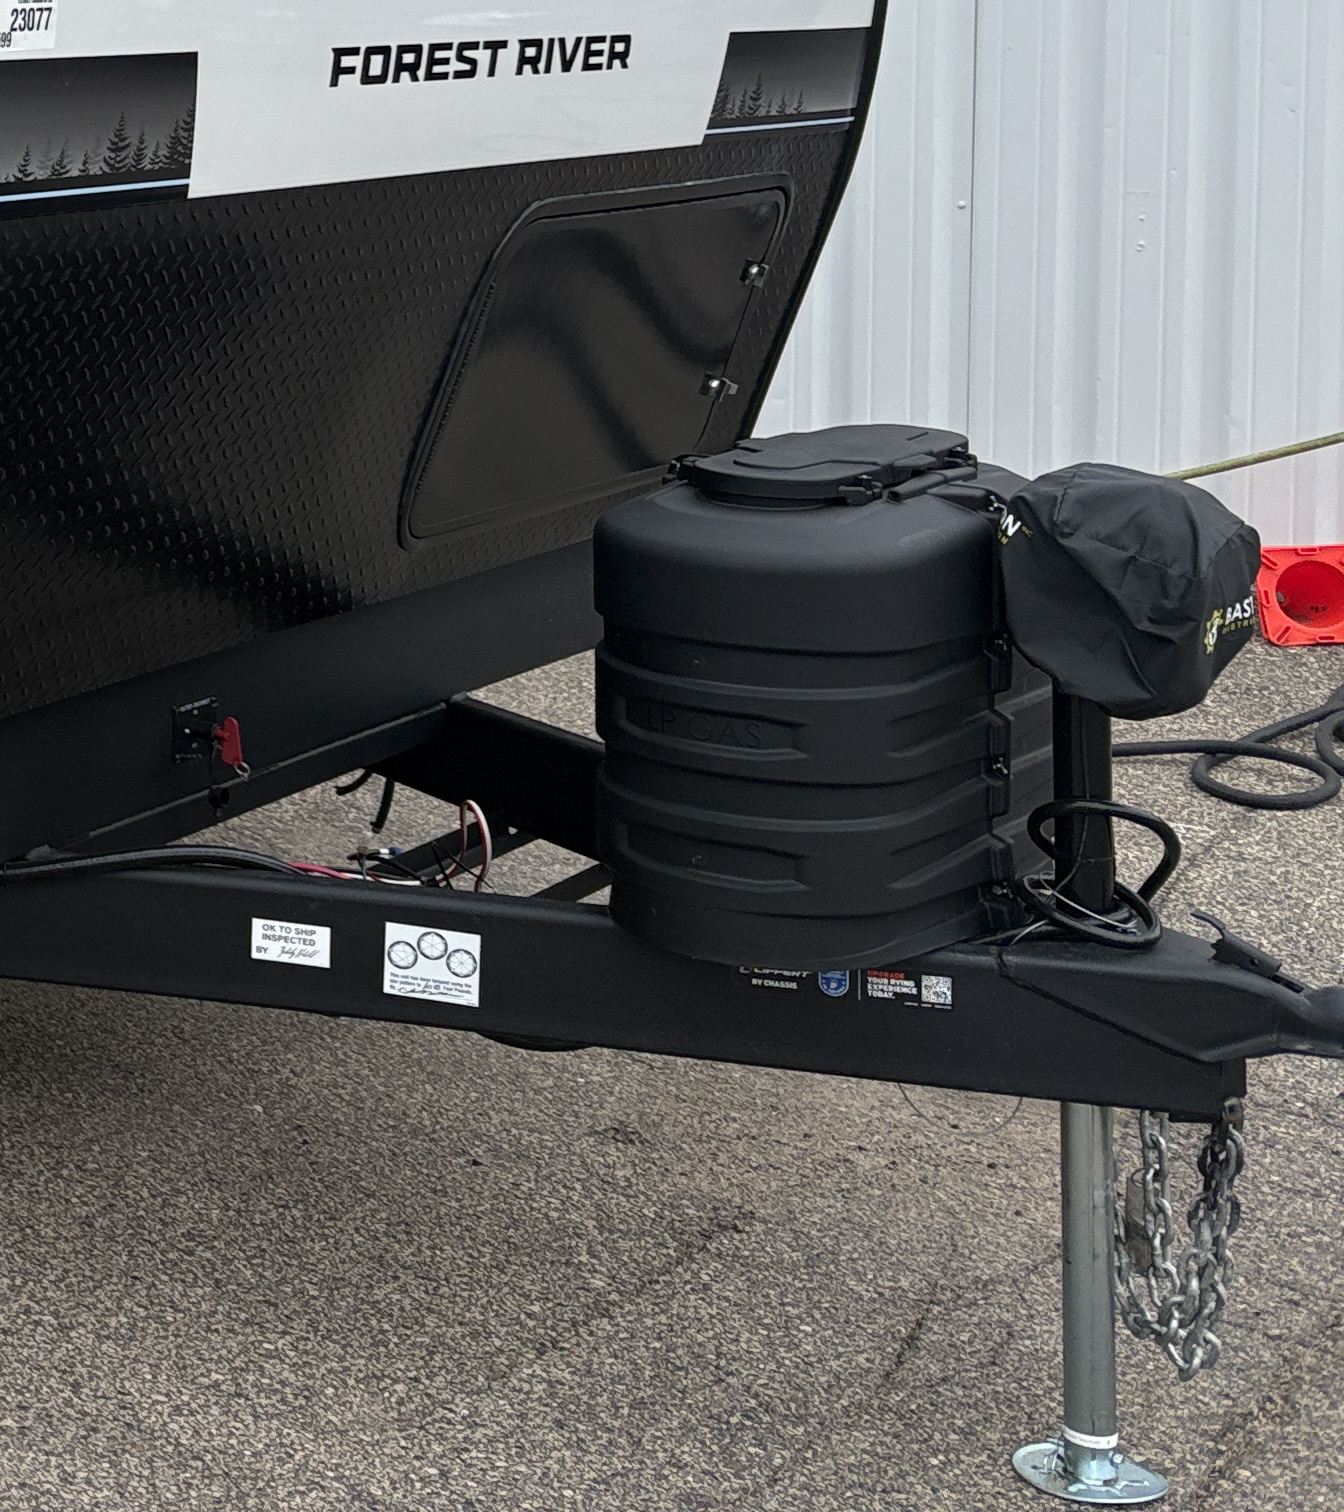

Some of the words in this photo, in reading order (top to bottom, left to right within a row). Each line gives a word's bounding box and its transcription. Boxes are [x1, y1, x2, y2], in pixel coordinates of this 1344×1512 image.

[10, 7, 52, 32] 23077
[329, 39, 509, 88] FOREST
[515, 34, 632, 76] RIVER
[686, 716, 762, 749] GAS
[261, 923, 277, 933] OK
[279, 925, 293, 935] TO
[294, 927, 317, 937] SHIP
[261, 933, 316, 947] INSPECTED
[255, 945, 269, 955] BY
[752, 978, 763, 986] RV
[763, 979, 798, 990] CHASSIS
[867, 977, 889, 985] YOUR
[867, 983, 918, 995] EXPERIENCE
